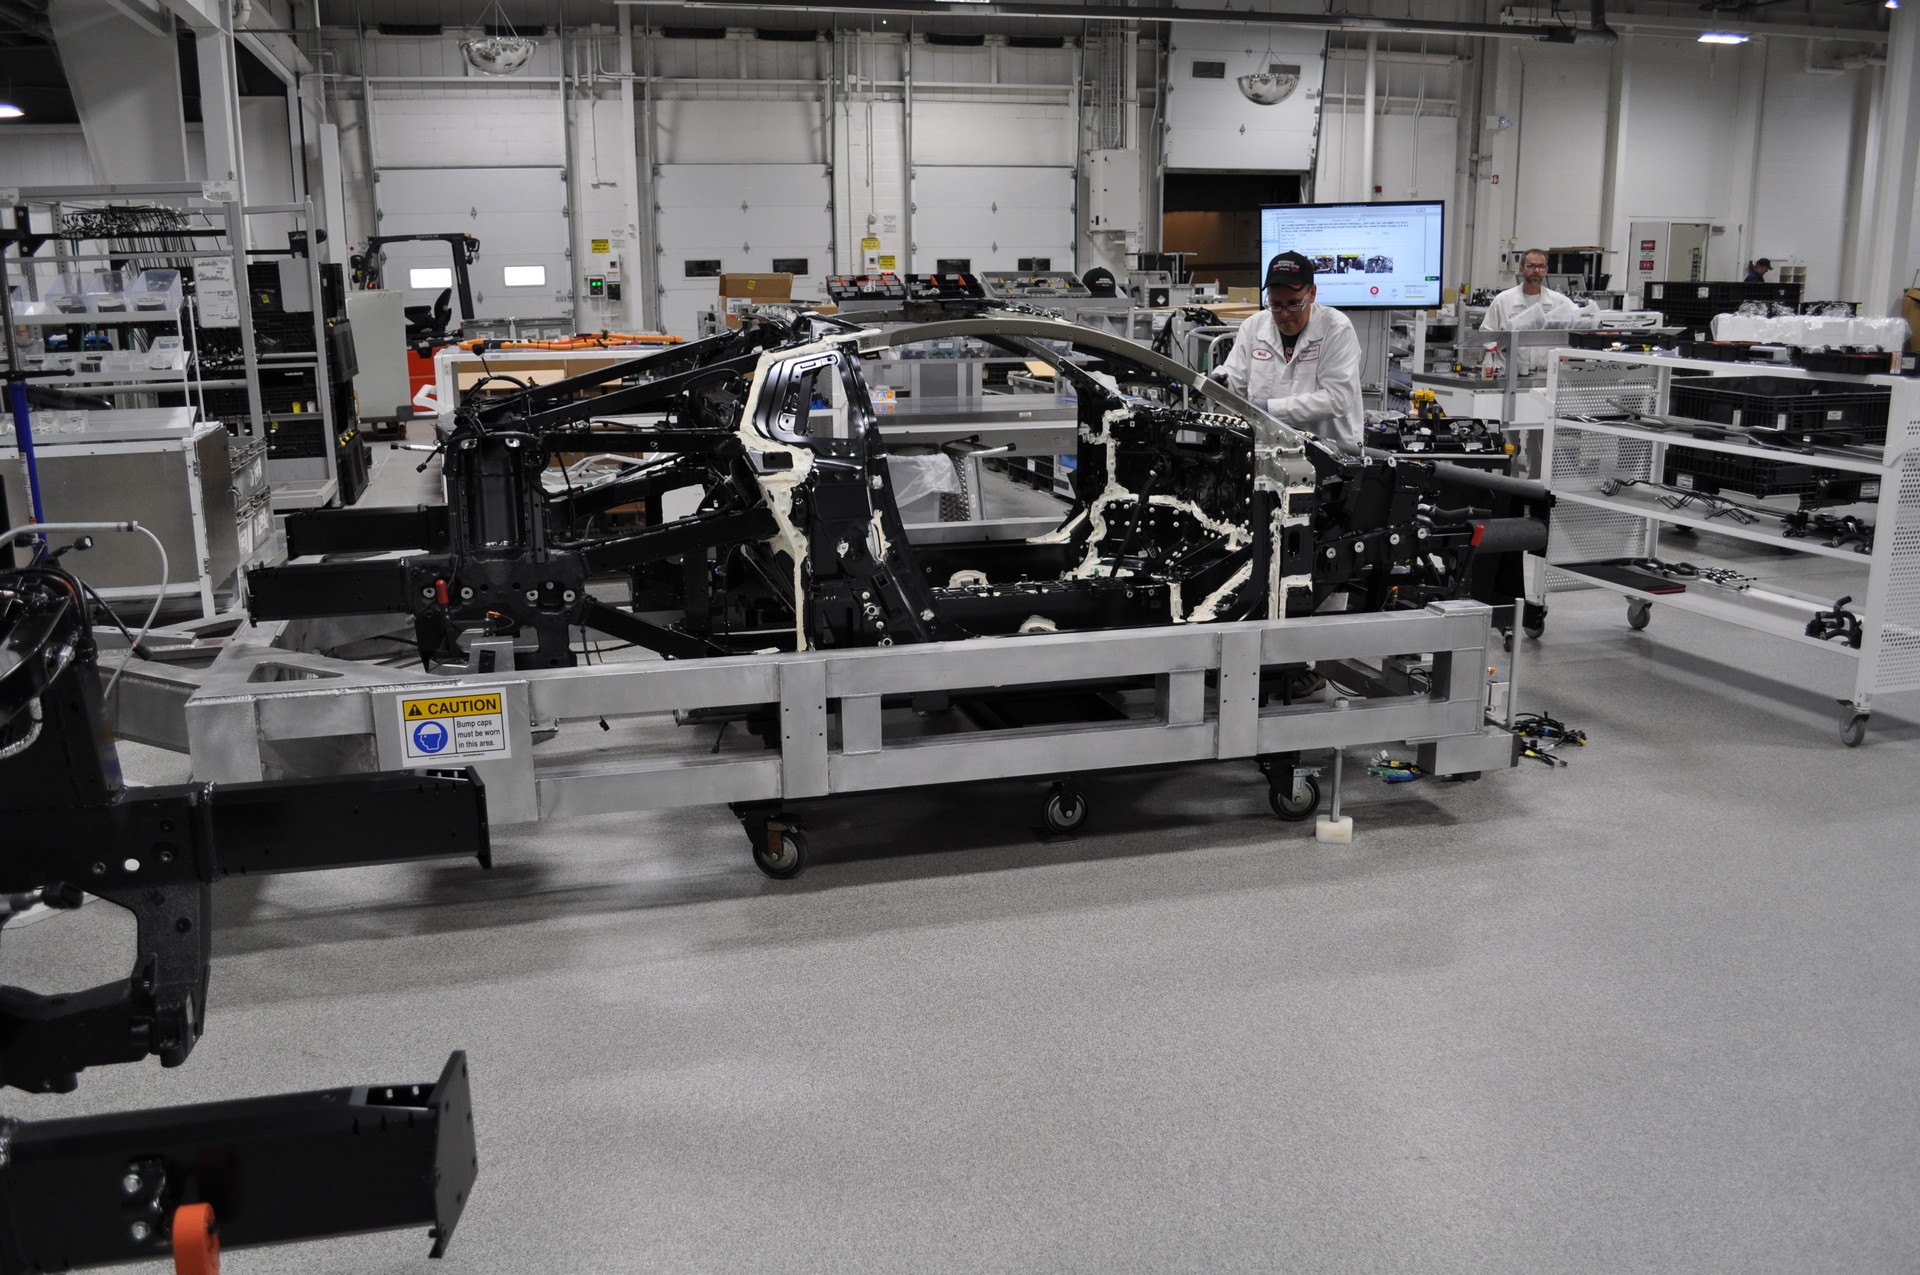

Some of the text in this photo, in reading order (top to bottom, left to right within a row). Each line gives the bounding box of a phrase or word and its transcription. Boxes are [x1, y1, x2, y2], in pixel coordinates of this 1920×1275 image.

[428, 698, 496, 715] CAUTION
[457, 721, 475, 729] Bump
[466, 740, 478, 748] this
